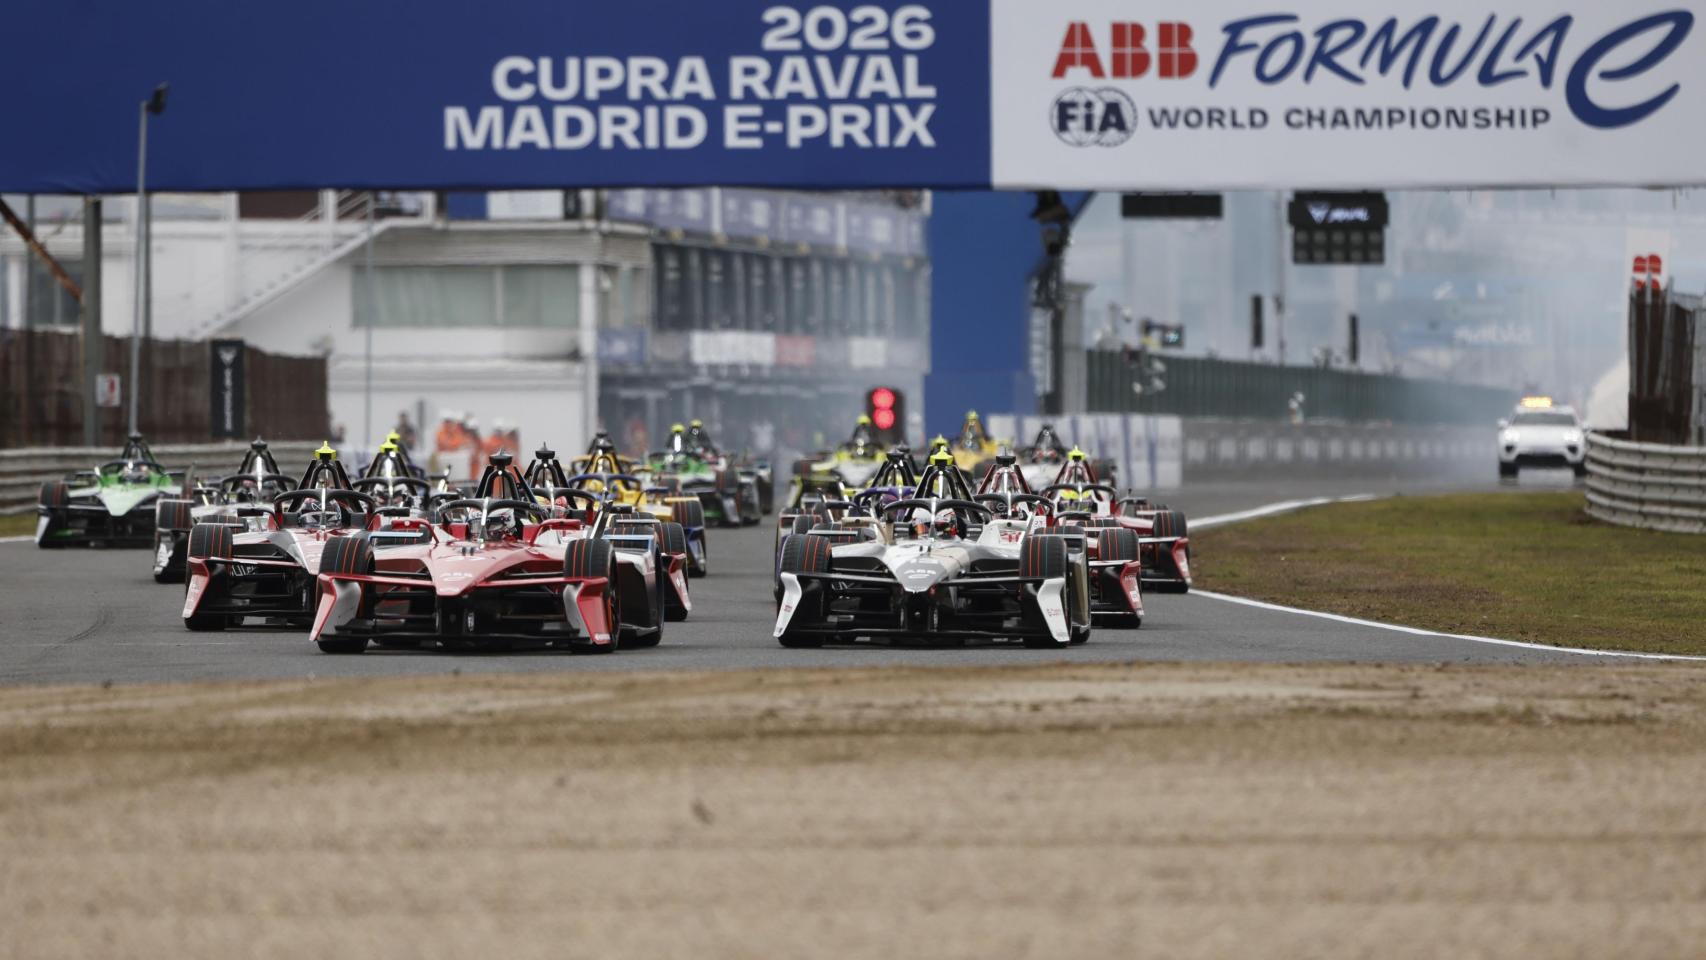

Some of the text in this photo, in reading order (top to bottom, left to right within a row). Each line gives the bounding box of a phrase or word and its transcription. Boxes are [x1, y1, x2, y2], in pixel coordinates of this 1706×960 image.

[762, 5, 935, 51] 2026
[1052, 22, 1198, 79] ABB
[1208, 12, 1574, 90] FORMULA
[492, 54, 936, 101] CUPRA RAVAL
[444, 103, 936, 150] MADRID E-PRIX
[1148, 107, 1269, 129] WORLD
[1284, 107, 1551, 130] CHAMPIONSHIP
